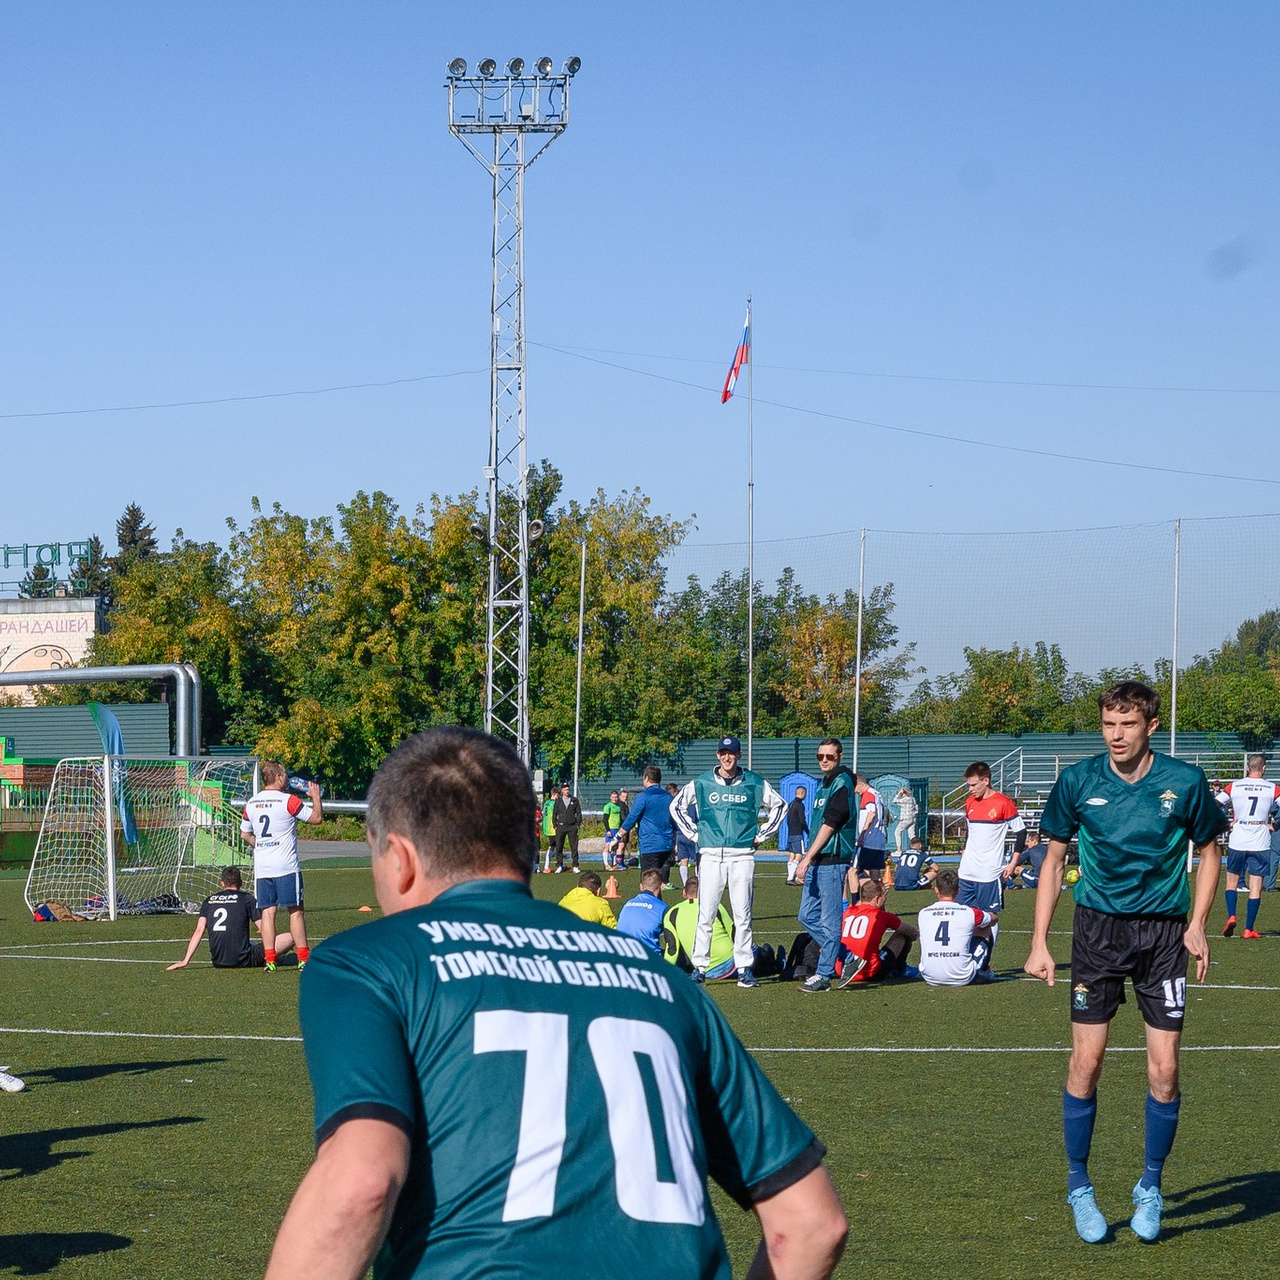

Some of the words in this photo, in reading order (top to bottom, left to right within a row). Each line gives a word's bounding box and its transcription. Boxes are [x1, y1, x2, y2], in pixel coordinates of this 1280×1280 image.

[721, 793, 747, 803] СБЕР
[1248, 796, 1258, 816] 7
[258, 814, 272, 837] 2
[900, 854, 918, 867] 10
[213, 907, 228, 931] 2
[842, 914, 870, 939] 10
[418, 920, 513, 949] УМВД
[508, 926, 614, 954] РОССИИ
[608, 935, 649, 961] ПО
[934, 920, 950, 946] 4
[429, 950, 562, 983] ТОМСКОЙ
[557, 959, 674, 1003] ОБЛАСТИ
[1162, 976, 1186, 1007] 10
[473, 1009, 706, 1226] 70
